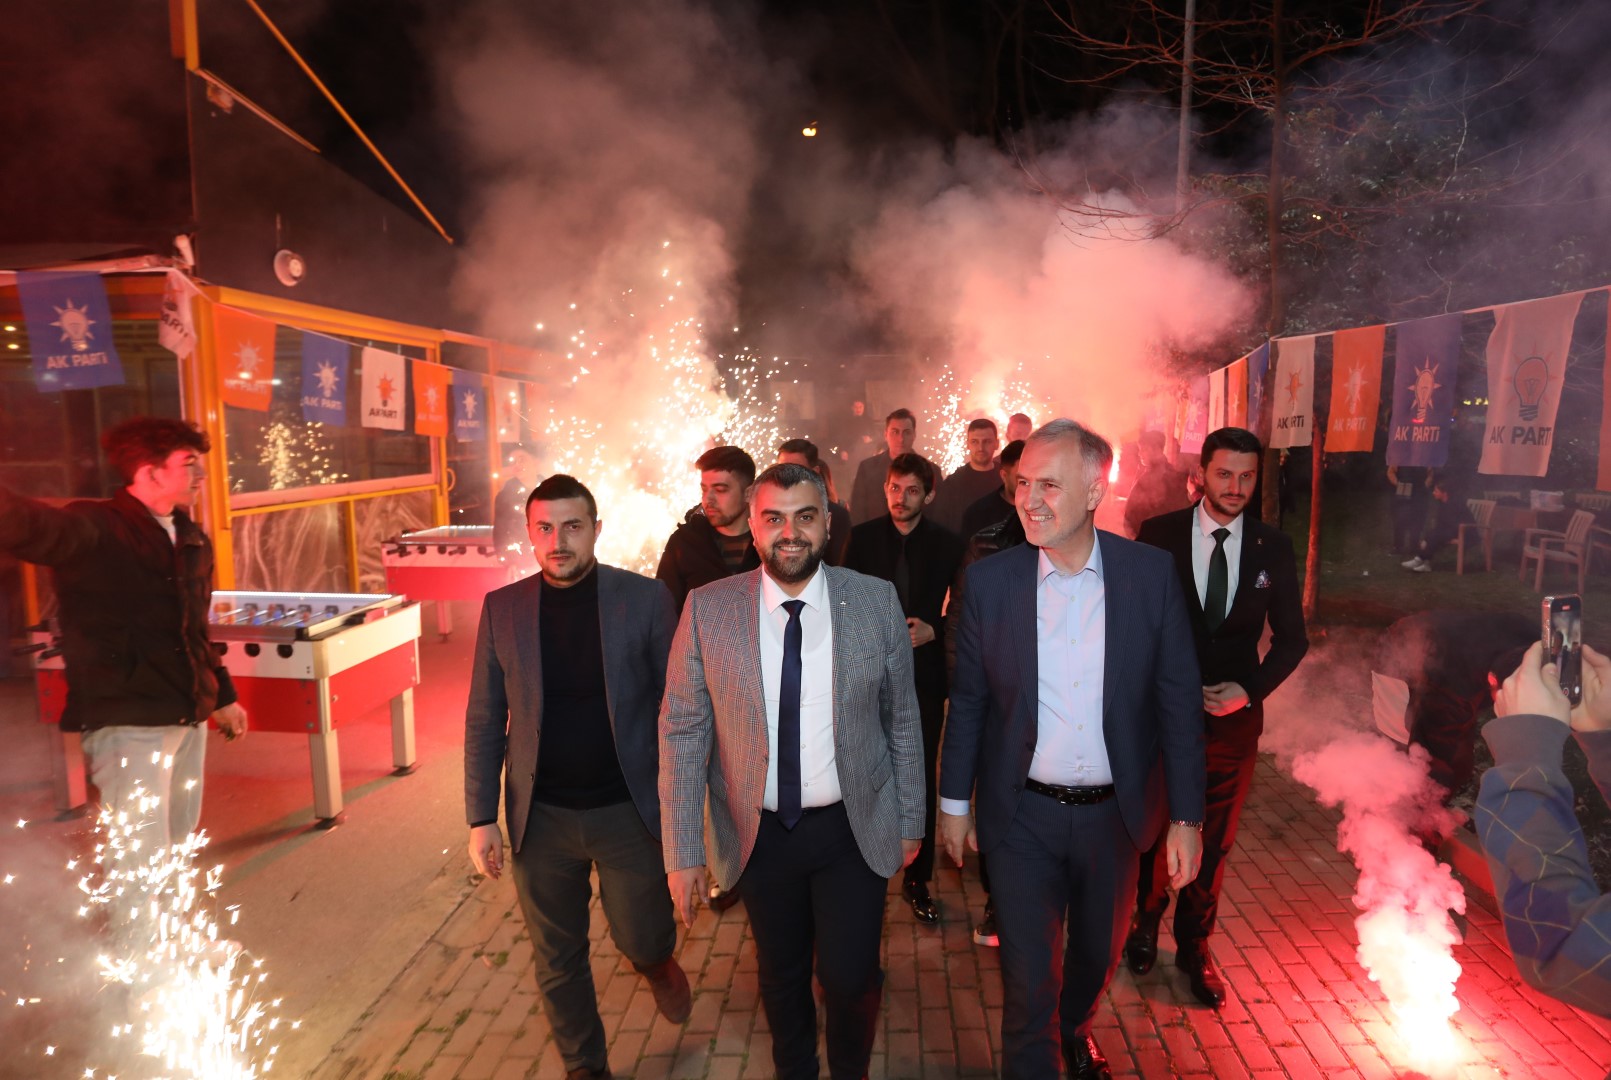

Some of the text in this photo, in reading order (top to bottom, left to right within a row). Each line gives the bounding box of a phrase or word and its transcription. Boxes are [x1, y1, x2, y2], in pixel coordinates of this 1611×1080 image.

[47, 355, 70, 369] AK
[1277, 416, 1289, 429] AK
[1333, 417, 1345, 432] AK
[1394, 425, 1409, 441] AK
[1489, 425, 1506, 443] AK
